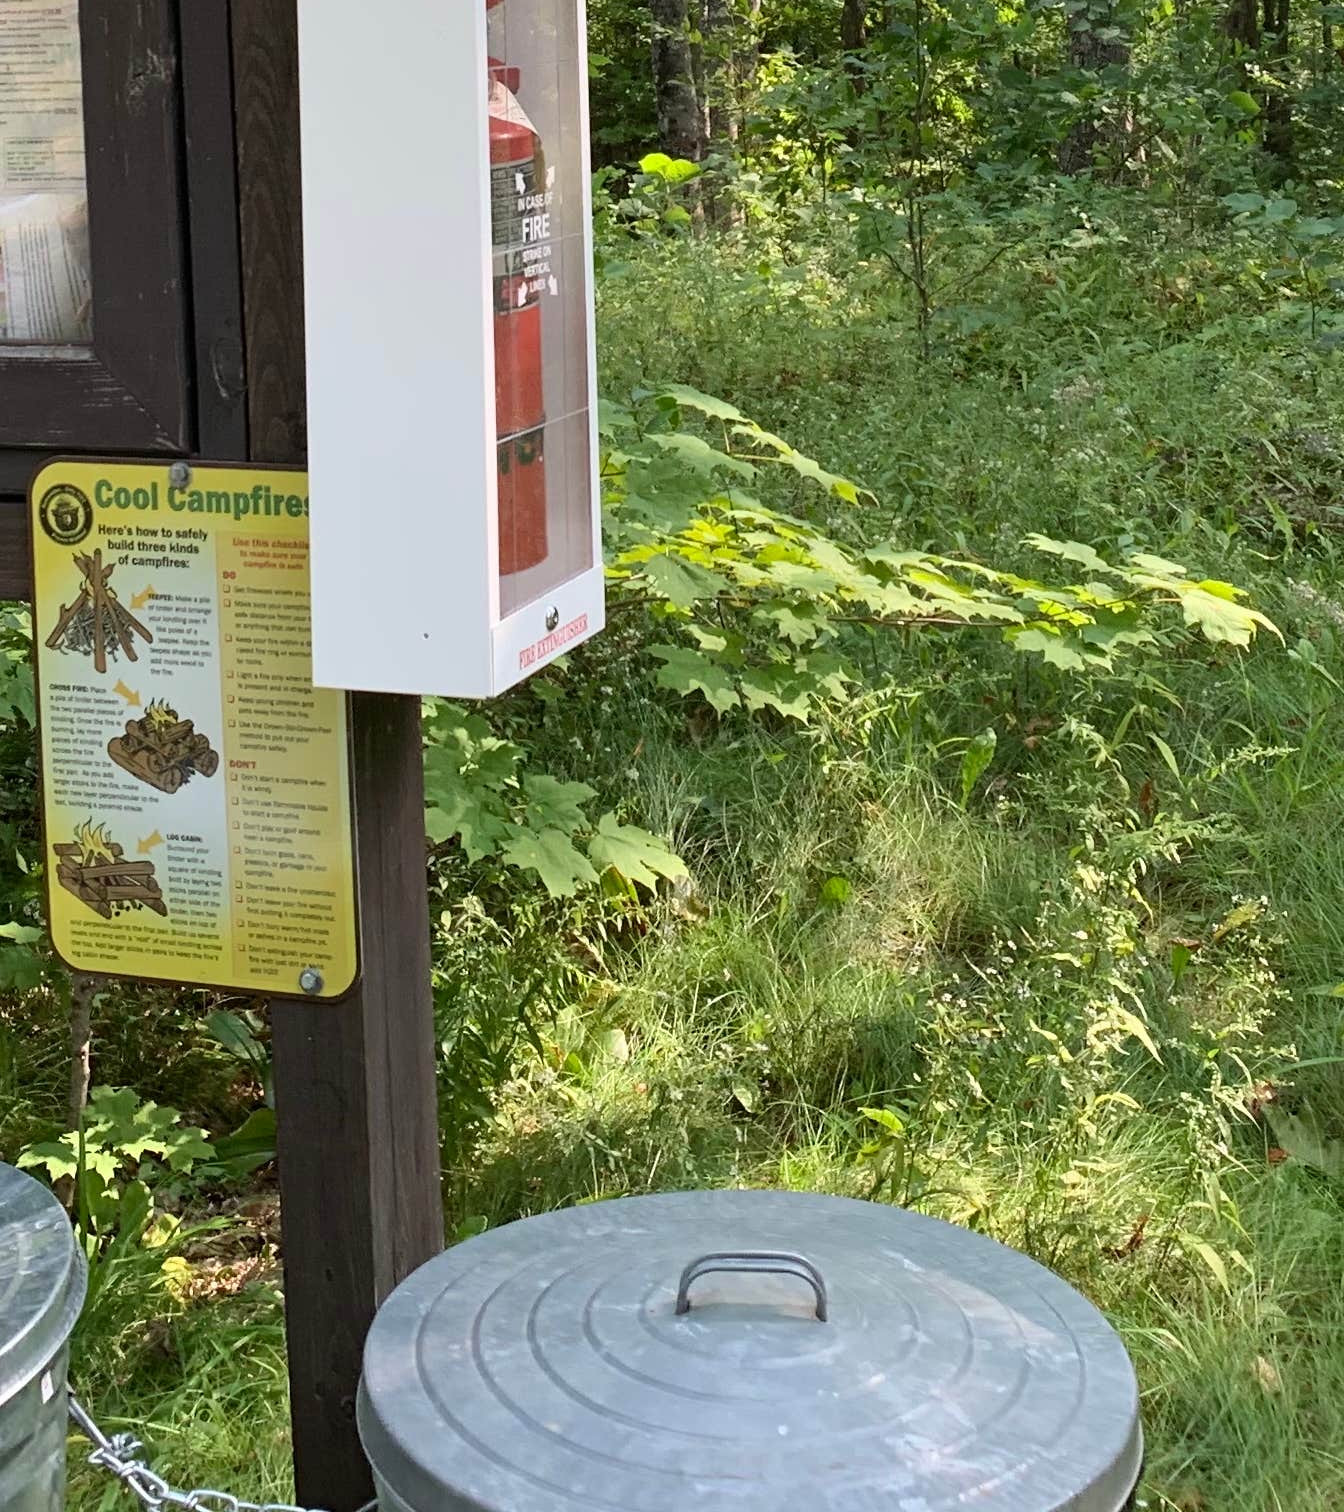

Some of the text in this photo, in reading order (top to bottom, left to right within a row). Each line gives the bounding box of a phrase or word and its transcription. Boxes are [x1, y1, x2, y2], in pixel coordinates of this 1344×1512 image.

[518, 191, 554, 212] IN CASE OF
[522, 213, 550, 243] FIRE
[523, 246, 552, 263] STRIKE ON
[524, 261, 550, 278] VERTICAL
[95, 479, 158, 510] Cool
[98, 524, 208, 541] Here's how to safely
[108, 539, 200, 554] build three kinds
[232, 538, 250, 546] Use
[252, 538, 269, 547] this
[118, 554, 190, 569] of campfires:
[240, 550, 248, 558] to
[250, 550, 270, 558] make
[272, 552, 288, 560] sure
[243, 560, 277, 569] campfire
[222, 570, 236, 580] DO
[519, 614, 588, 670] FIRE EXTINGUISHER
[230, 760, 256, 769] DON'T
